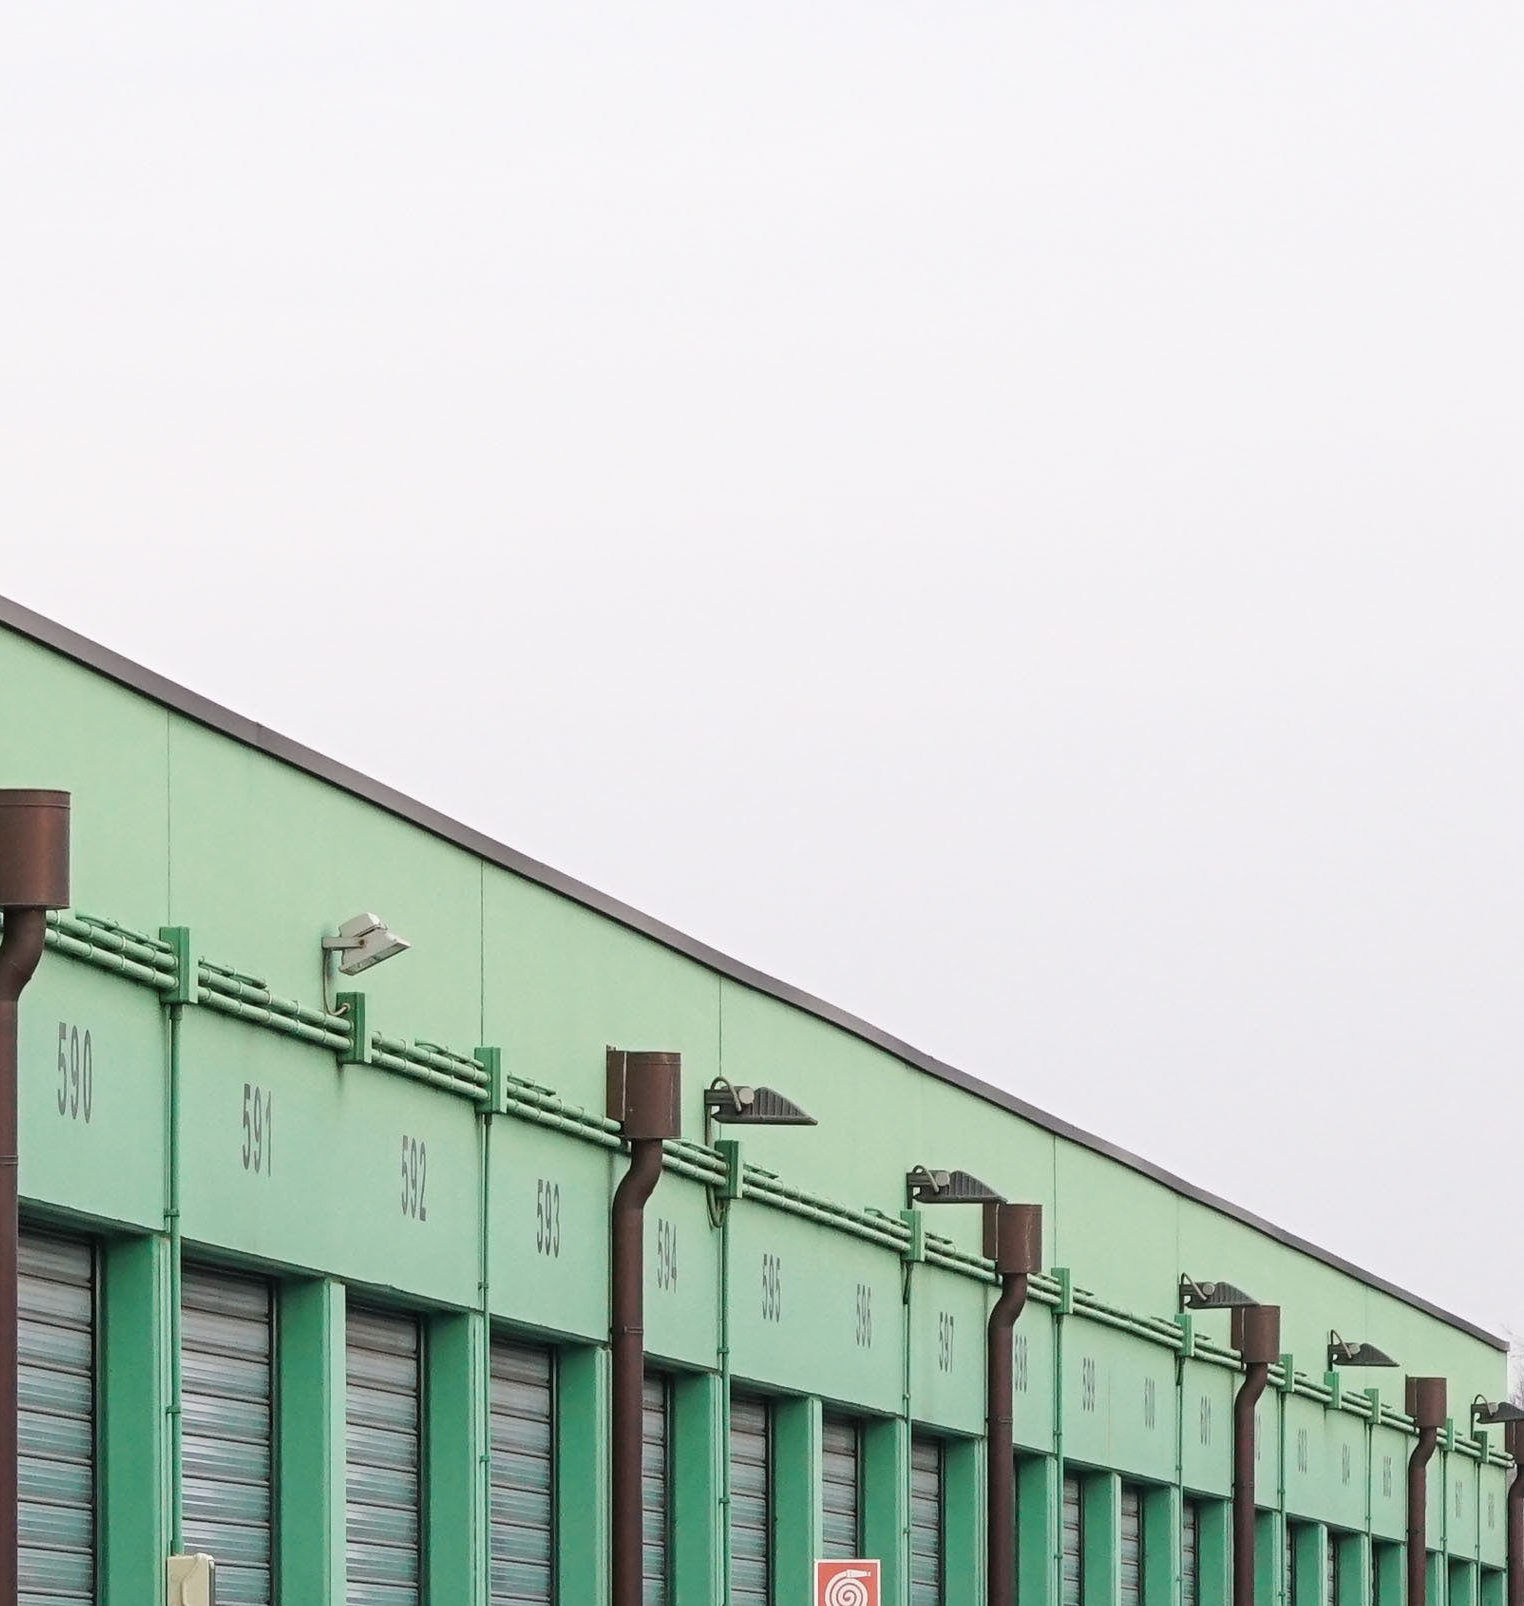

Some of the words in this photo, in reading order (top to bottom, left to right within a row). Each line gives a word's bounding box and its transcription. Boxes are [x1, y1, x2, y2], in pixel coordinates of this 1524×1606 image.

[57, 1021, 93, 1125] 590
[242, 1082, 272, 1177] 591
[401, 1134, 427, 1222] 592
[536, 1178, 560, 1259] 593
[657, 1218, 678, 1293] 594
[762, 1253, 781, 1324] 595
[855, 1283, 872, 1349] 596
[938, 1311, 954, 1373] 597
